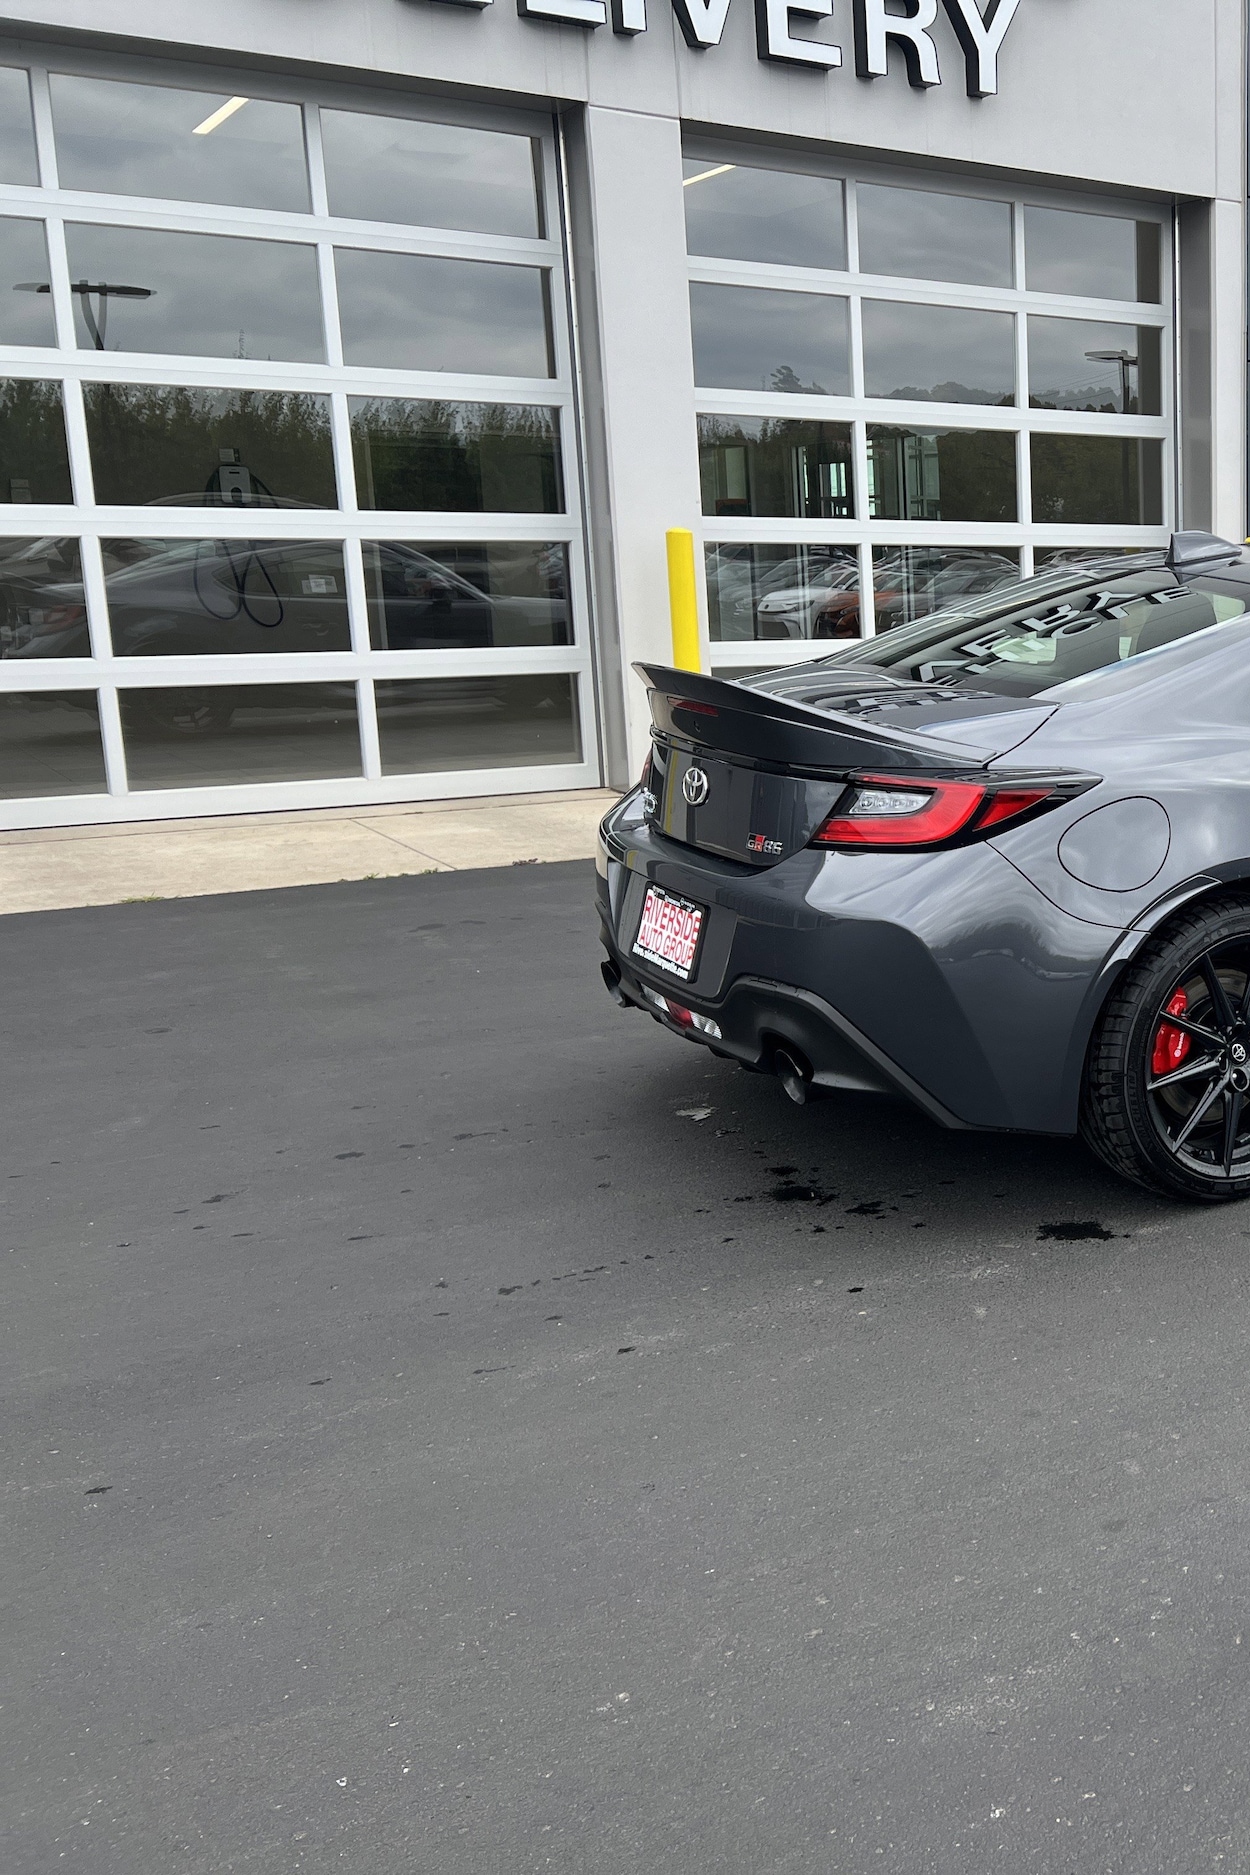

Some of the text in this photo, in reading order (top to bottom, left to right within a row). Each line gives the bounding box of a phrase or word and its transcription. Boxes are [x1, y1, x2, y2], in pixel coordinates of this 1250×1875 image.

[643, 895, 702, 945] RIVERSIDE
[640, 924, 695, 966] AUTO GROUP
